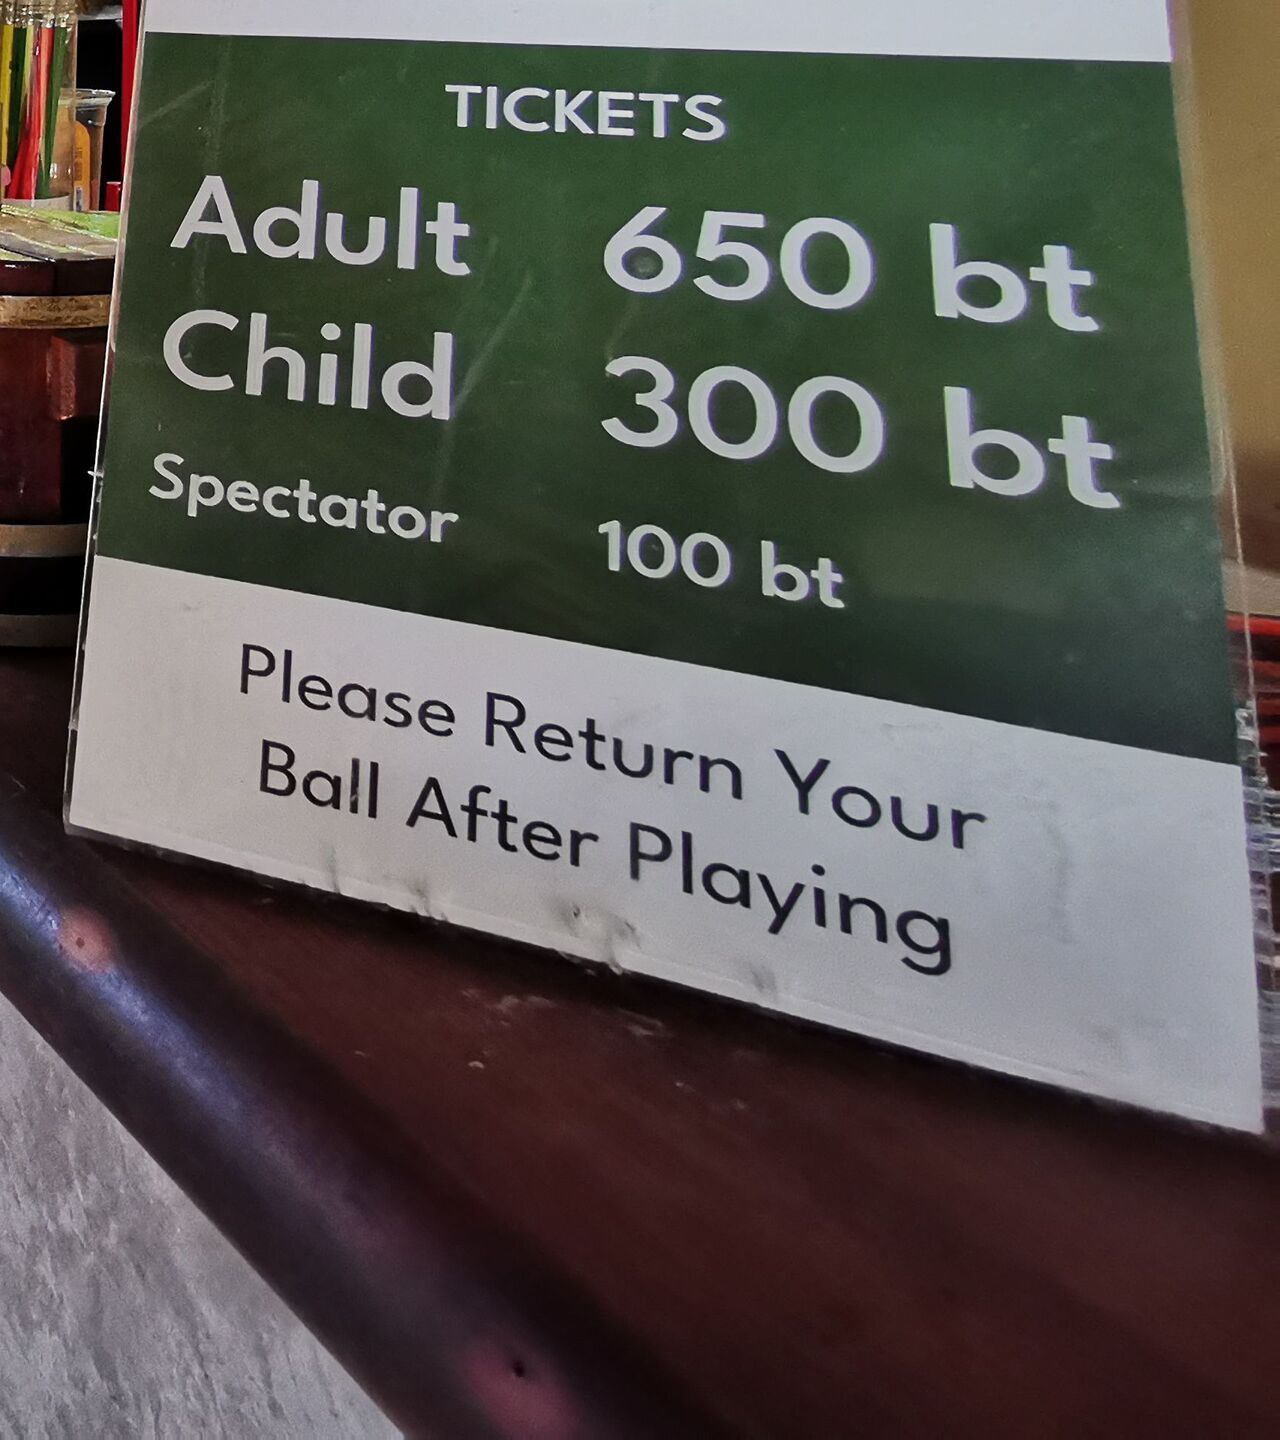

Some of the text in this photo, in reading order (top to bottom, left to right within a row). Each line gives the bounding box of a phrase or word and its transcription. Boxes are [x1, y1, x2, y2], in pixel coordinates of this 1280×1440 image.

[445, 84, 728, 142] TICKETS
[169, 174, 1100, 333] Adult 650 bt
[162, 309, 1121, 510] Child 300 bt
[148, 452, 845, 609] Spectator 100 bt
[238, 643, 988, 851] Please Return Your
[257, 738, 953, 978] Ball After Playing
